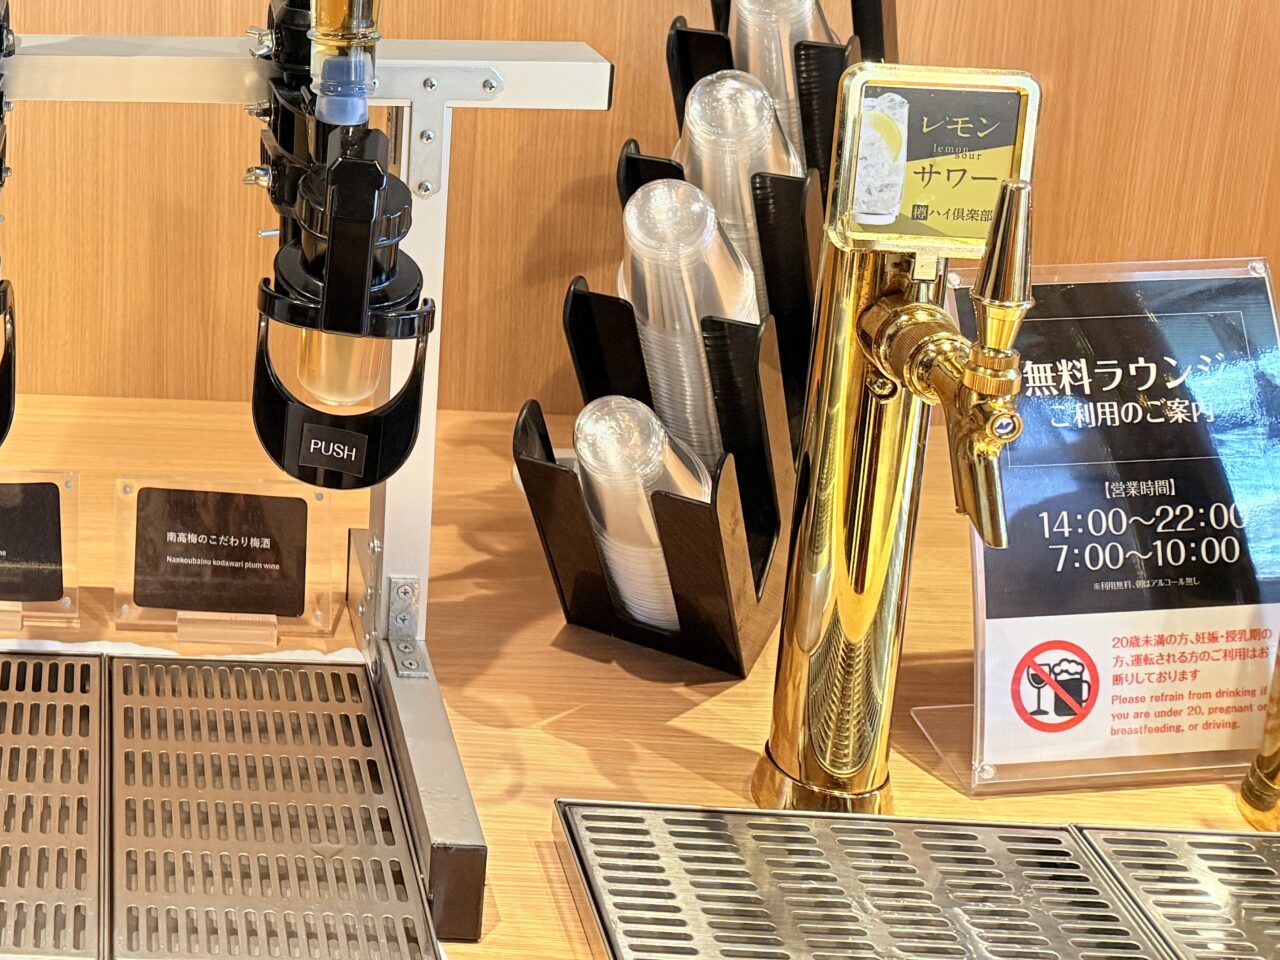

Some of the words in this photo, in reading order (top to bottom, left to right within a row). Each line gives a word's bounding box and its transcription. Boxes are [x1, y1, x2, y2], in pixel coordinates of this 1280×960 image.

[922, 116, 1000, 138] レモン
[933, 143, 969, 153] lemon
[954, 152, 982, 160] sour
[913, 163, 998, 189] サワー
[911, 205, 994, 222] 樽ハイ倶楽部
[1022, 352, 1225, 397] 無料ラウンジ
[1050, 398, 1214, 428] ご利用のご案内
[310, 439, 356, 461] PUSH
[166, 531, 271, 549] 南高梅のこだわり梅酒
[212, 558, 244, 568] kodawari
[244, 560, 263, 571] plum
[263, 562, 280, 570] wine
[1112, 646, 1269, 668] 方、運転される方のご利用はお
[1112, 669, 1200, 686] 断りしております
[1111, 694, 1146, 705] Please
[1150, 692, 1185, 703] refrain
[1188, 690, 1212, 700] from
[1215, 688, 1257, 698] drinking
[1260, 686, 1268, 696] if
[1111, 711, 1129, 721] you
[1132, 710, 1150, 719] are
[1154, 707, 1183, 718] under
[1208, 703, 1253, 715] pregnant
[1257, 704, 1268, 712] or
[1188, 722, 1198, 730] or
[1202, 720, 1240, 730] driving.
